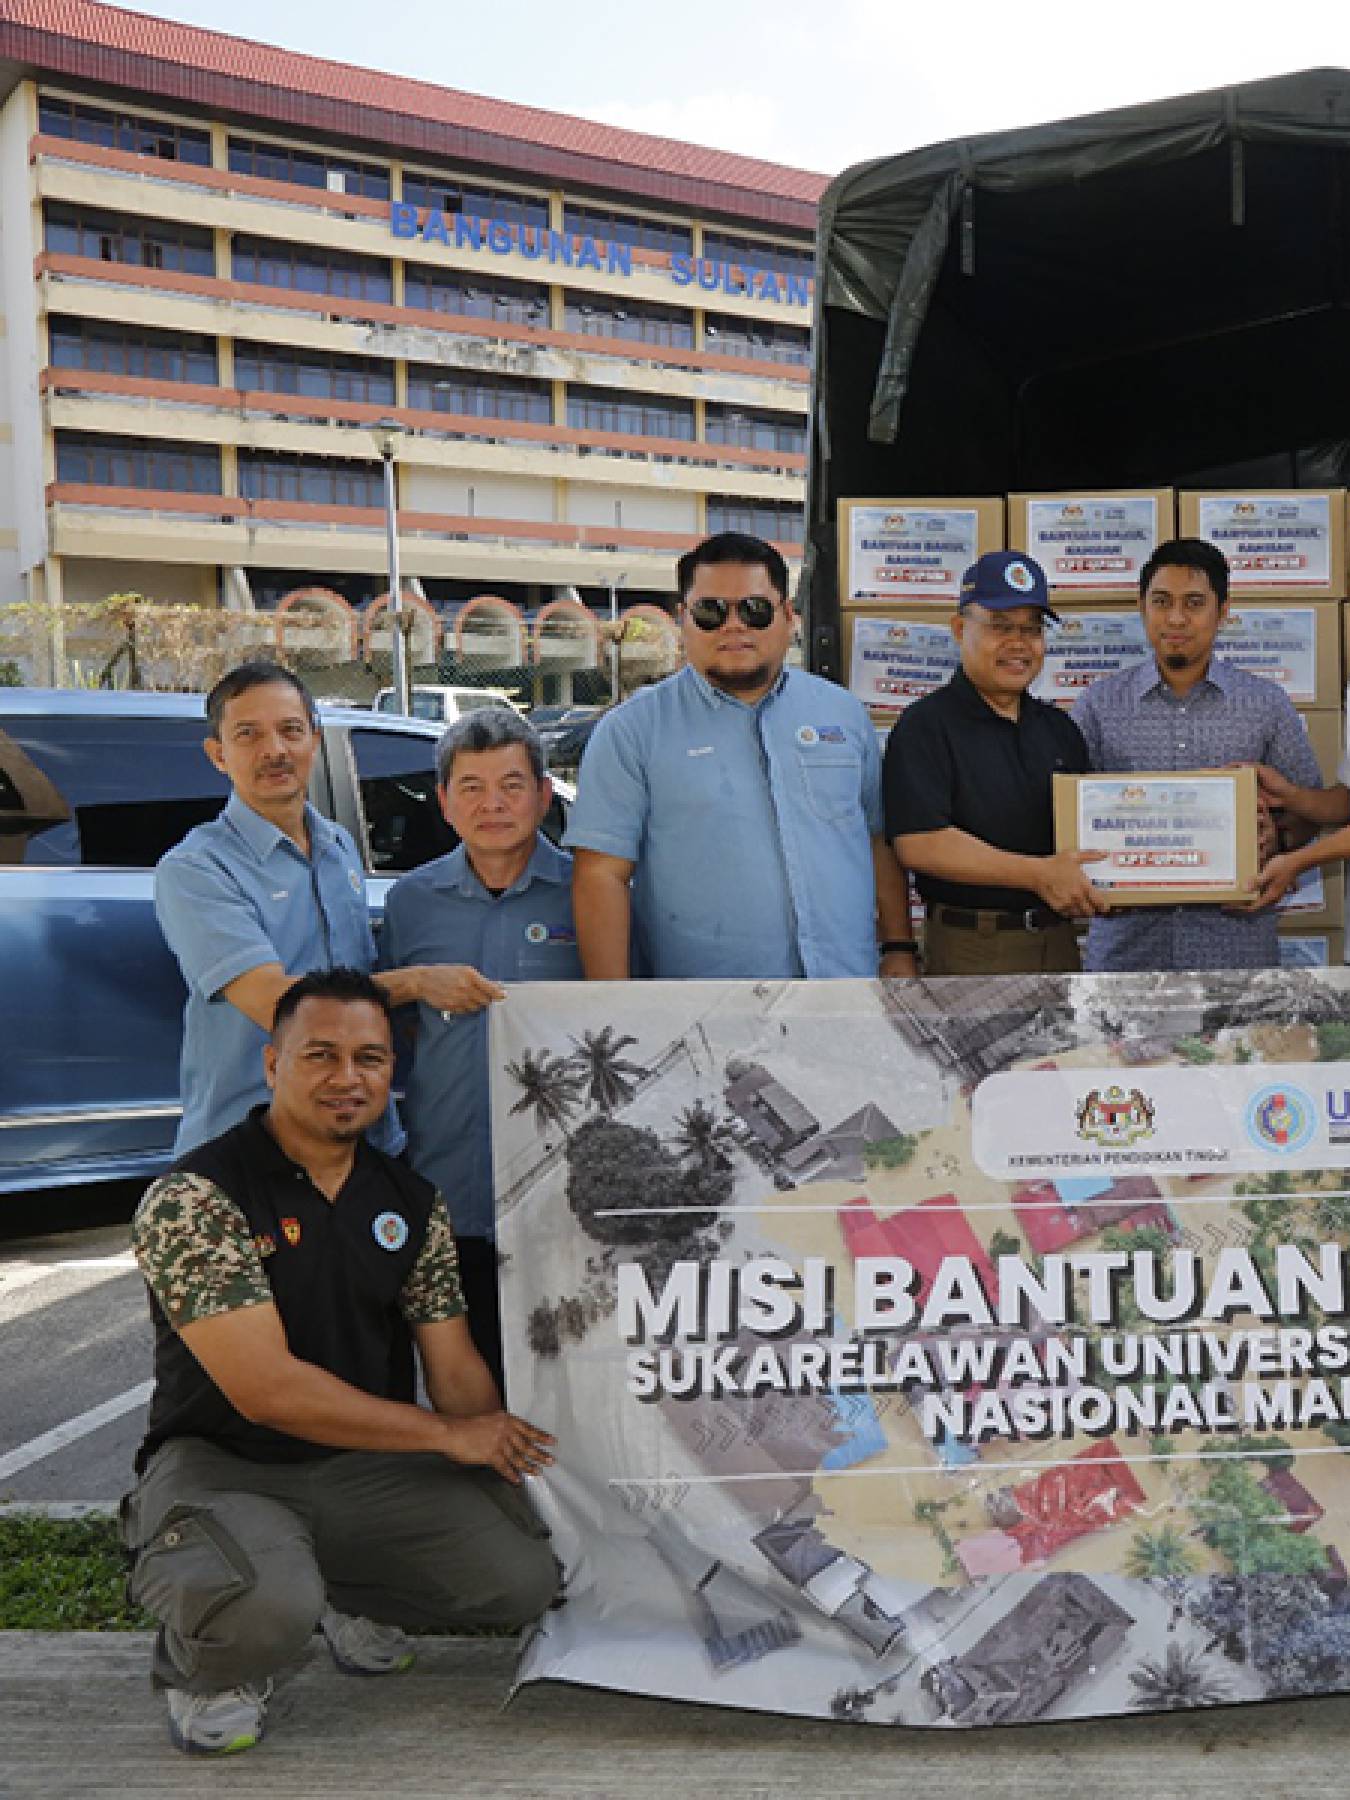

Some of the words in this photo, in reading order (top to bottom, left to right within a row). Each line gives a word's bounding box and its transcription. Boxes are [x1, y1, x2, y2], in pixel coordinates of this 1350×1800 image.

[391, 201, 632, 276] BANGUNAN
[671, 254, 809, 306] SULTAN
[1007, 1153, 1101, 1167] KEMENTERIAN
[1103, 1151, 1182, 1165] PENDIDIKAN
[617, 1256, 833, 1343] MISI
[856, 1241, 1347, 1332] BANTUAN
[627, 1335, 1088, 1401] SUKARELAWAN
[922, 1382, 1236, 1444] NASIONAL
